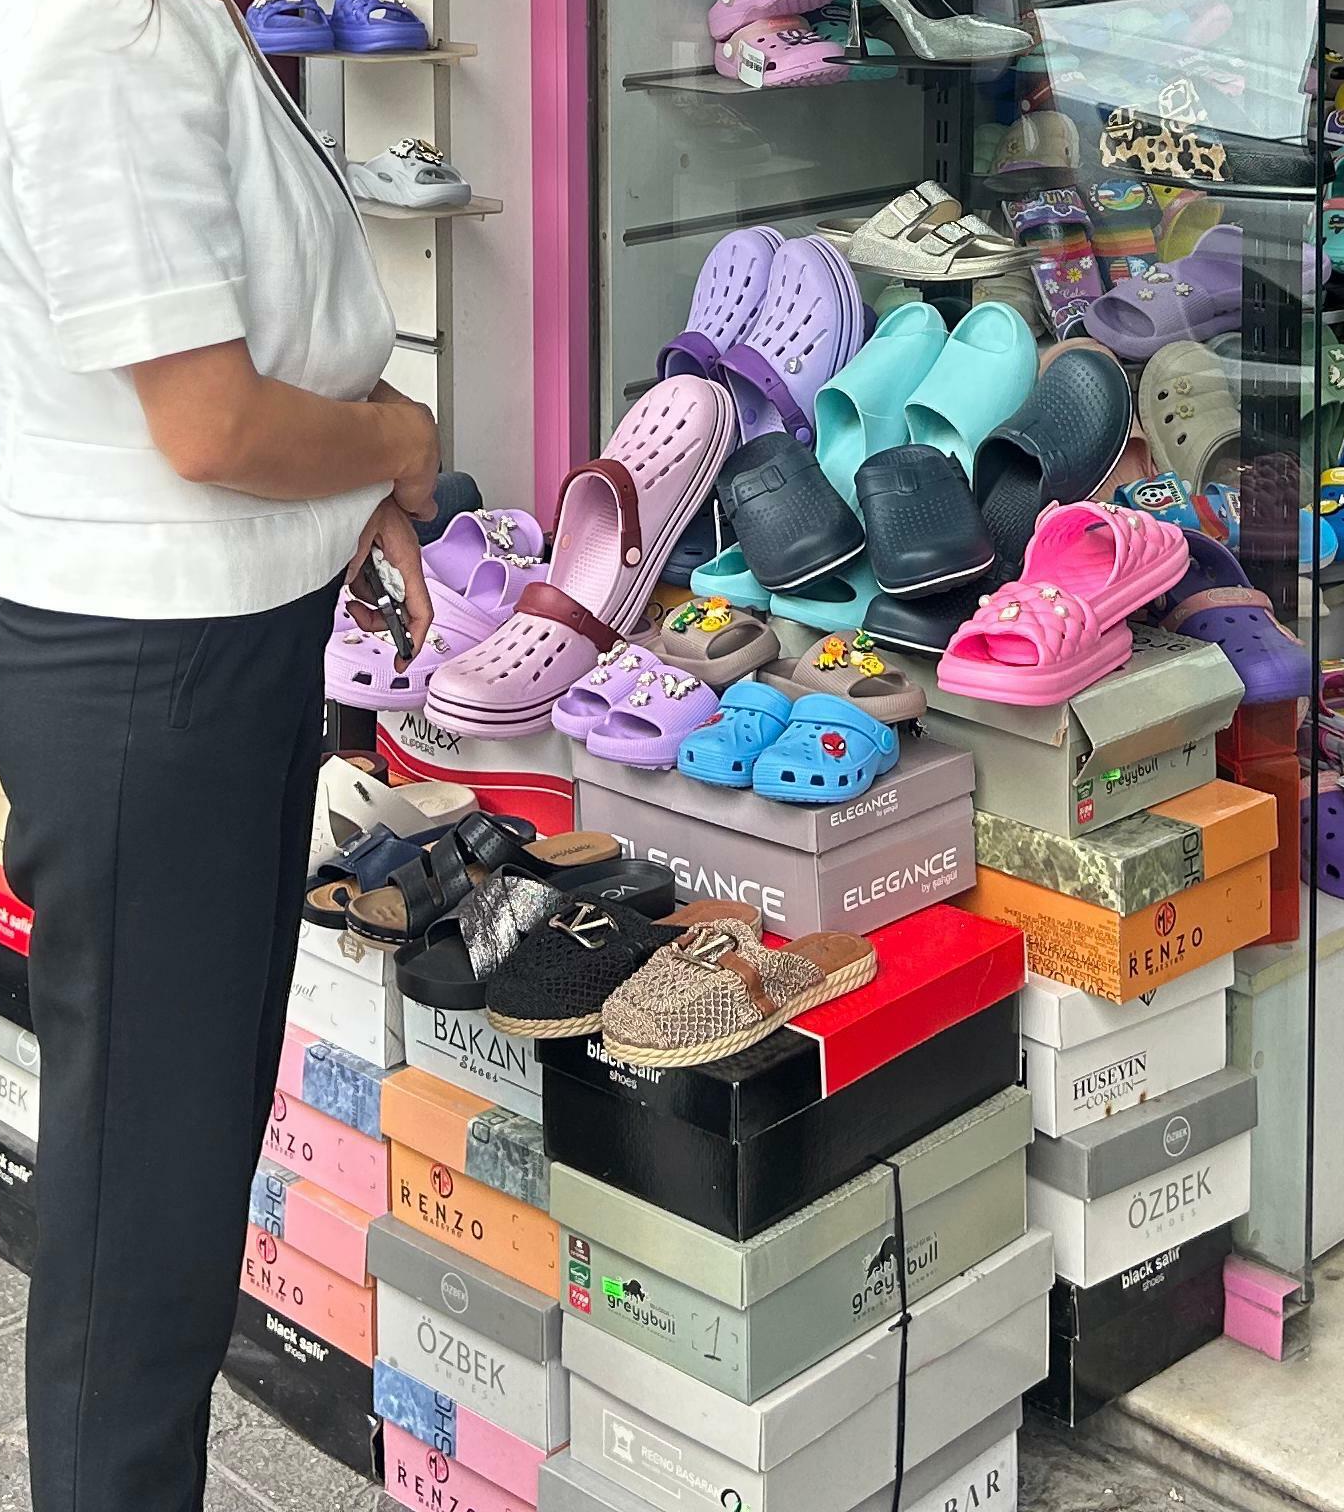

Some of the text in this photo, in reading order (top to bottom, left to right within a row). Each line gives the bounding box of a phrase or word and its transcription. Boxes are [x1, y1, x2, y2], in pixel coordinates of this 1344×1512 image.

[830, 790, 898, 827] ELEGANCE
[843, 847, 957, 912] ELEGANCE
[1129, 926, 1203, 978] RENZO
[434, 1007, 528, 1078] BAKAN
[270, 1124, 314, 1162] NZO
[400, 1186, 484, 1240] RENZO
[1128, 1166, 1213, 1229] ÖZBEK
[246, 1257, 304, 1306] ENZO
[851, 1240, 939, 1316] greybull
[1121, 1260, 1154, 1289] black
[265, 1312, 298, 1346] black
[607, 1292, 676, 1336] greyybull
[417, 1314, 507, 1396] ÖZBEK
[396, 1464, 479, 1512] RENZ
